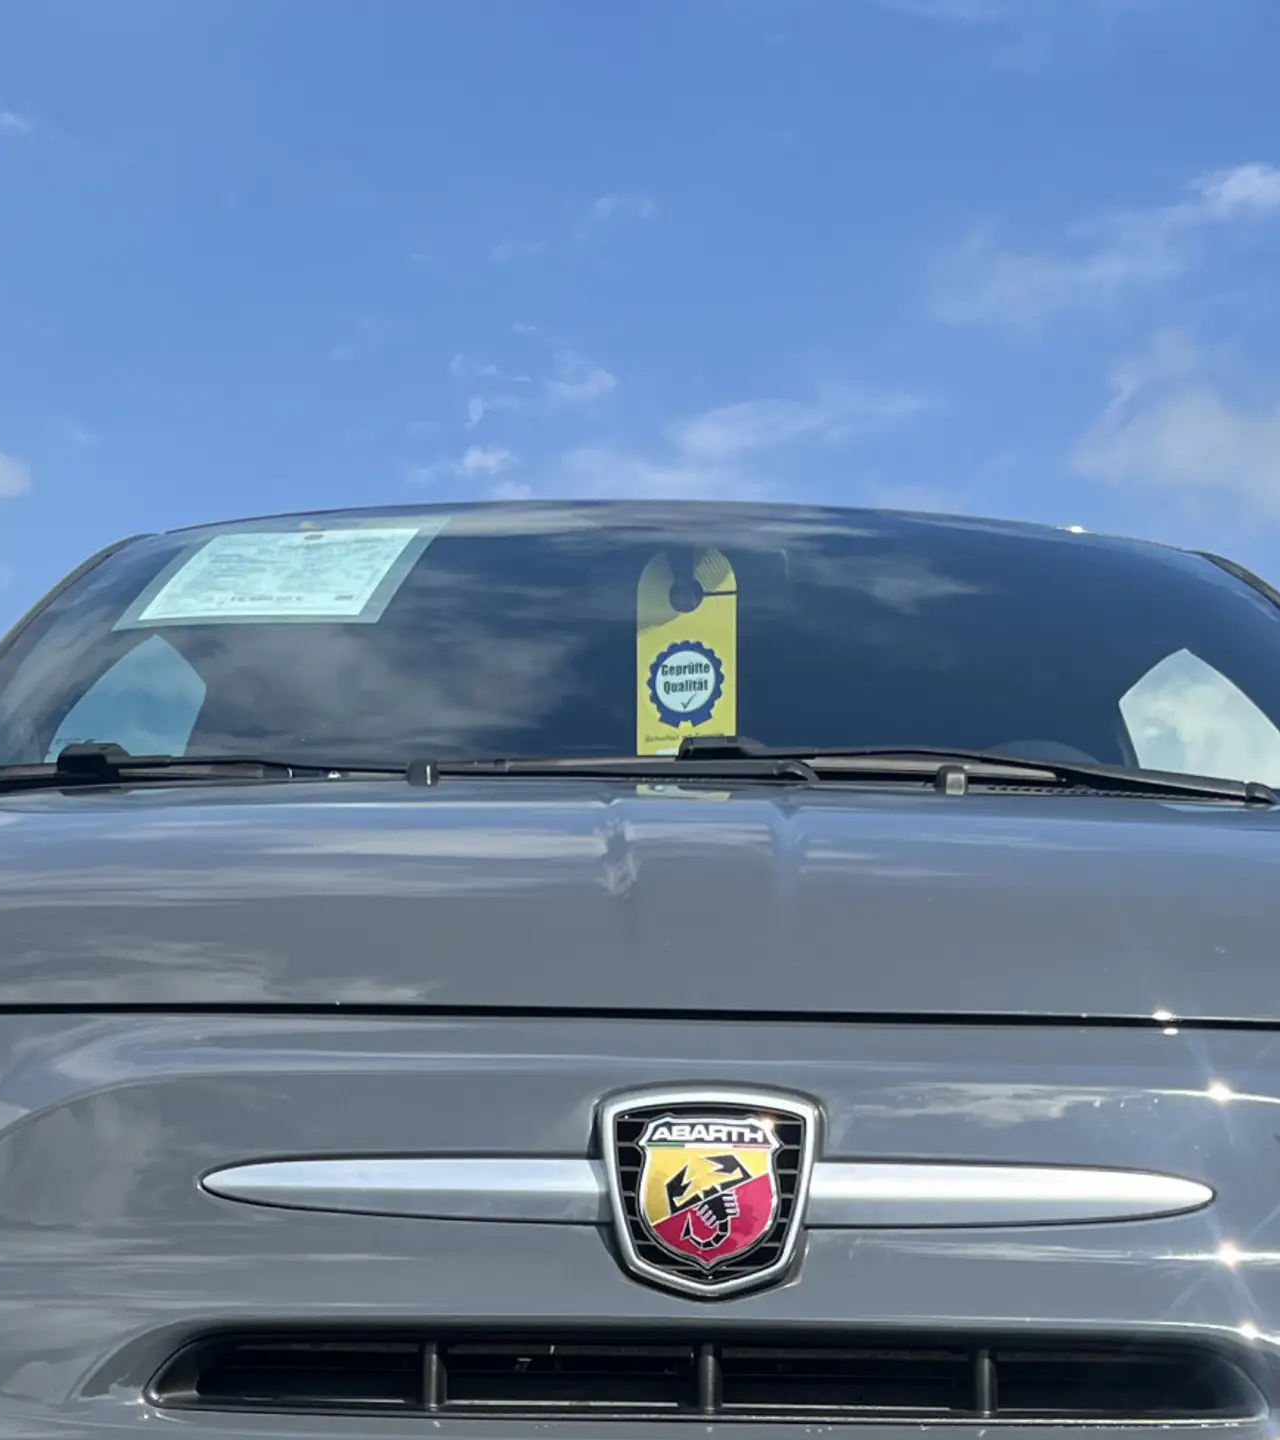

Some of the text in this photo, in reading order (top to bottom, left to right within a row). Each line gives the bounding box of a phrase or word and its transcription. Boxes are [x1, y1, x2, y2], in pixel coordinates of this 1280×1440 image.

[661, 662, 710, 676] Geprüfte
[663, 678, 708, 694] Qualität
[652, 1124, 764, 1143] ABARTH
